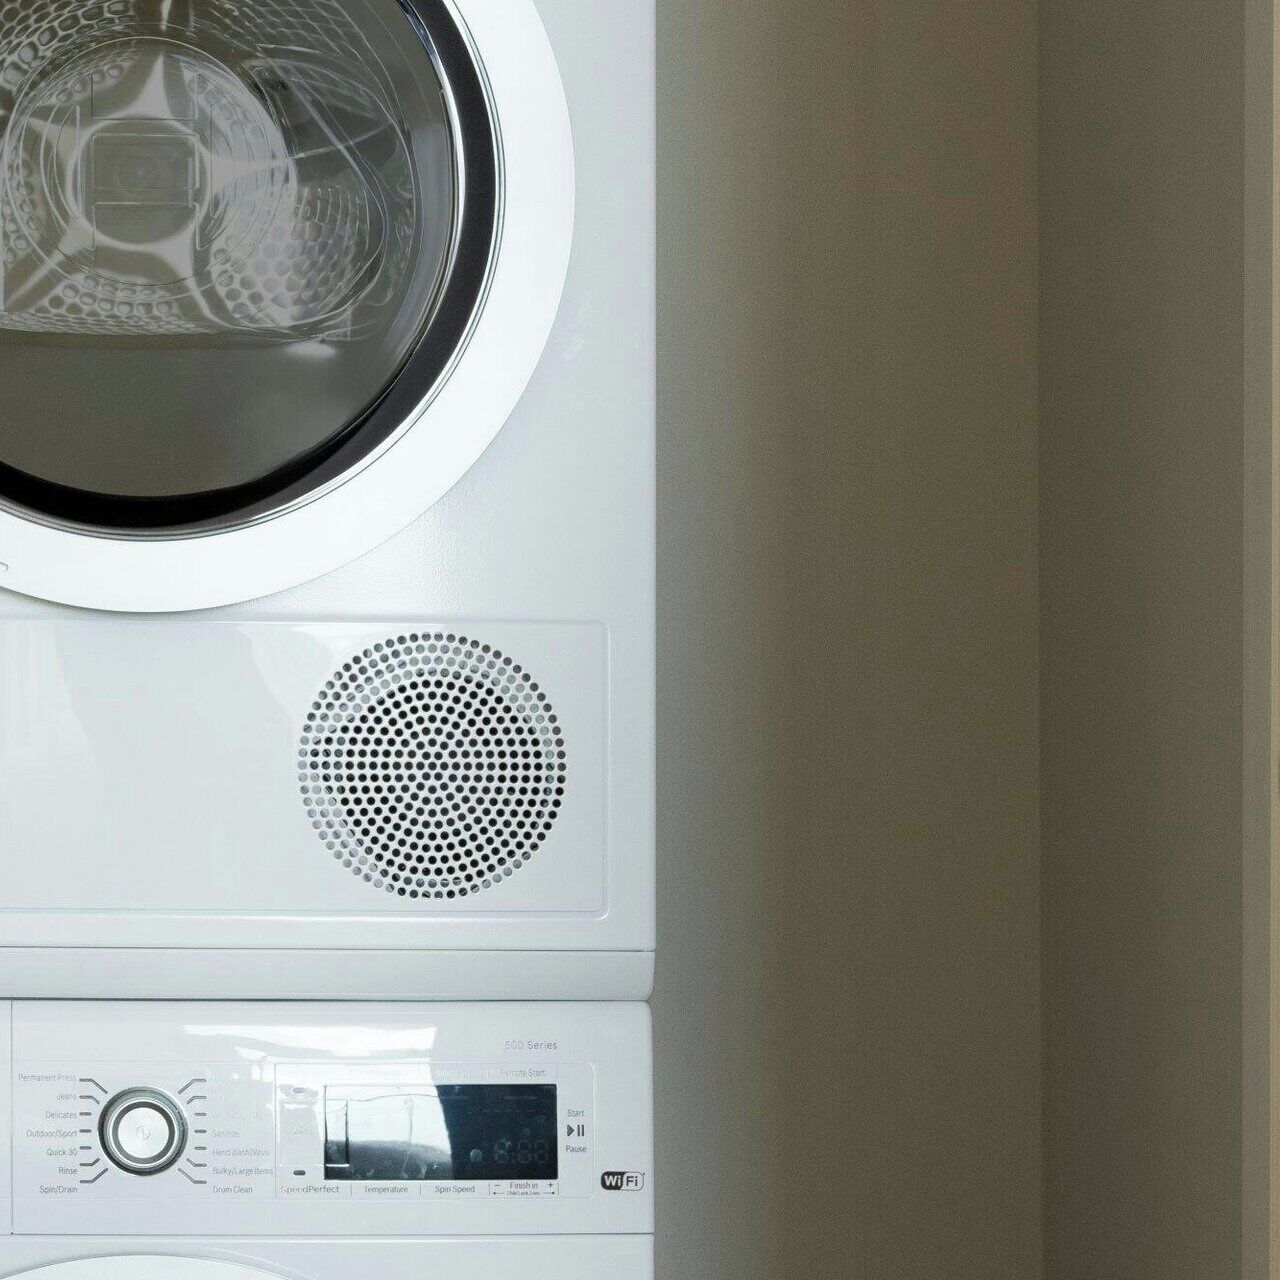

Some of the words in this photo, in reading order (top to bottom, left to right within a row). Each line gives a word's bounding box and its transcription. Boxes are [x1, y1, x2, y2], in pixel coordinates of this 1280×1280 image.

[504, 1040, 523, 1050] 500
[527, 1040, 558, 1050] Series
[18, 1074, 56, 1082] Permanent
[57, 1074, 77, 1082] Press
[528, 1069, 547, 1078] Start
[56, 1093, 77, 1101] Jeans
[45, 1111, 77, 1119] Delicates
[567, 1109, 585, 1117] Start
[26, 1129, 77, 1138] Outdoor/Sport
[47, 1148, 67, 1157] Quick
[68, 1148, 78, 1156] 30
[212, 1149, 230, 1157] Hand
[565, 1145, 587, 1153] Pause
[58, 1166, 78, 1175] Rinse
[39, 1185, 78, 1194] Spin/Drain
[212, 1186, 232, 1194] Drum
[233, 1185, 253, 1194] Clean
[280, 1184, 340, 1195] SpeedPerfect
[435, 1184, 451, 1195] Spin
[452, 1184, 476, 1195] Speed
[509, 1181, 529, 1189] Finish
[364, 1185, 408, 1195] Temperature
